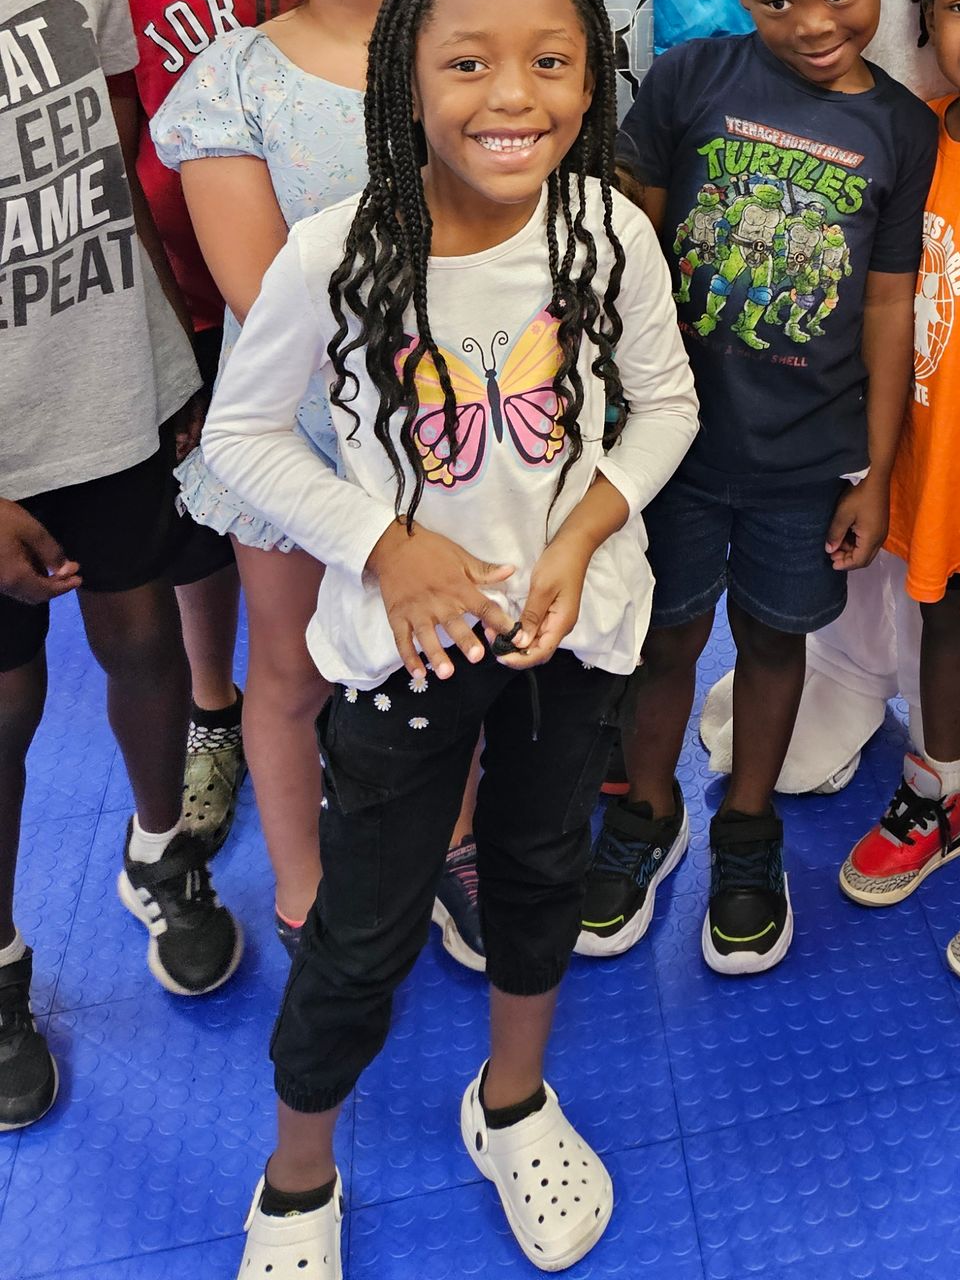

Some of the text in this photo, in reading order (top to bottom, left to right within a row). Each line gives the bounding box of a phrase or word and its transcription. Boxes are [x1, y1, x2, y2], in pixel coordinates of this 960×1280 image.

[0, 16, 61, 109] AT
[0, 86, 102, 189] EEP
[696, 136, 868, 215] TURTLES
[725, 115, 861, 165] TEENAGE MUTANT NINJA
[770, 354, 809, 368] SHELL
